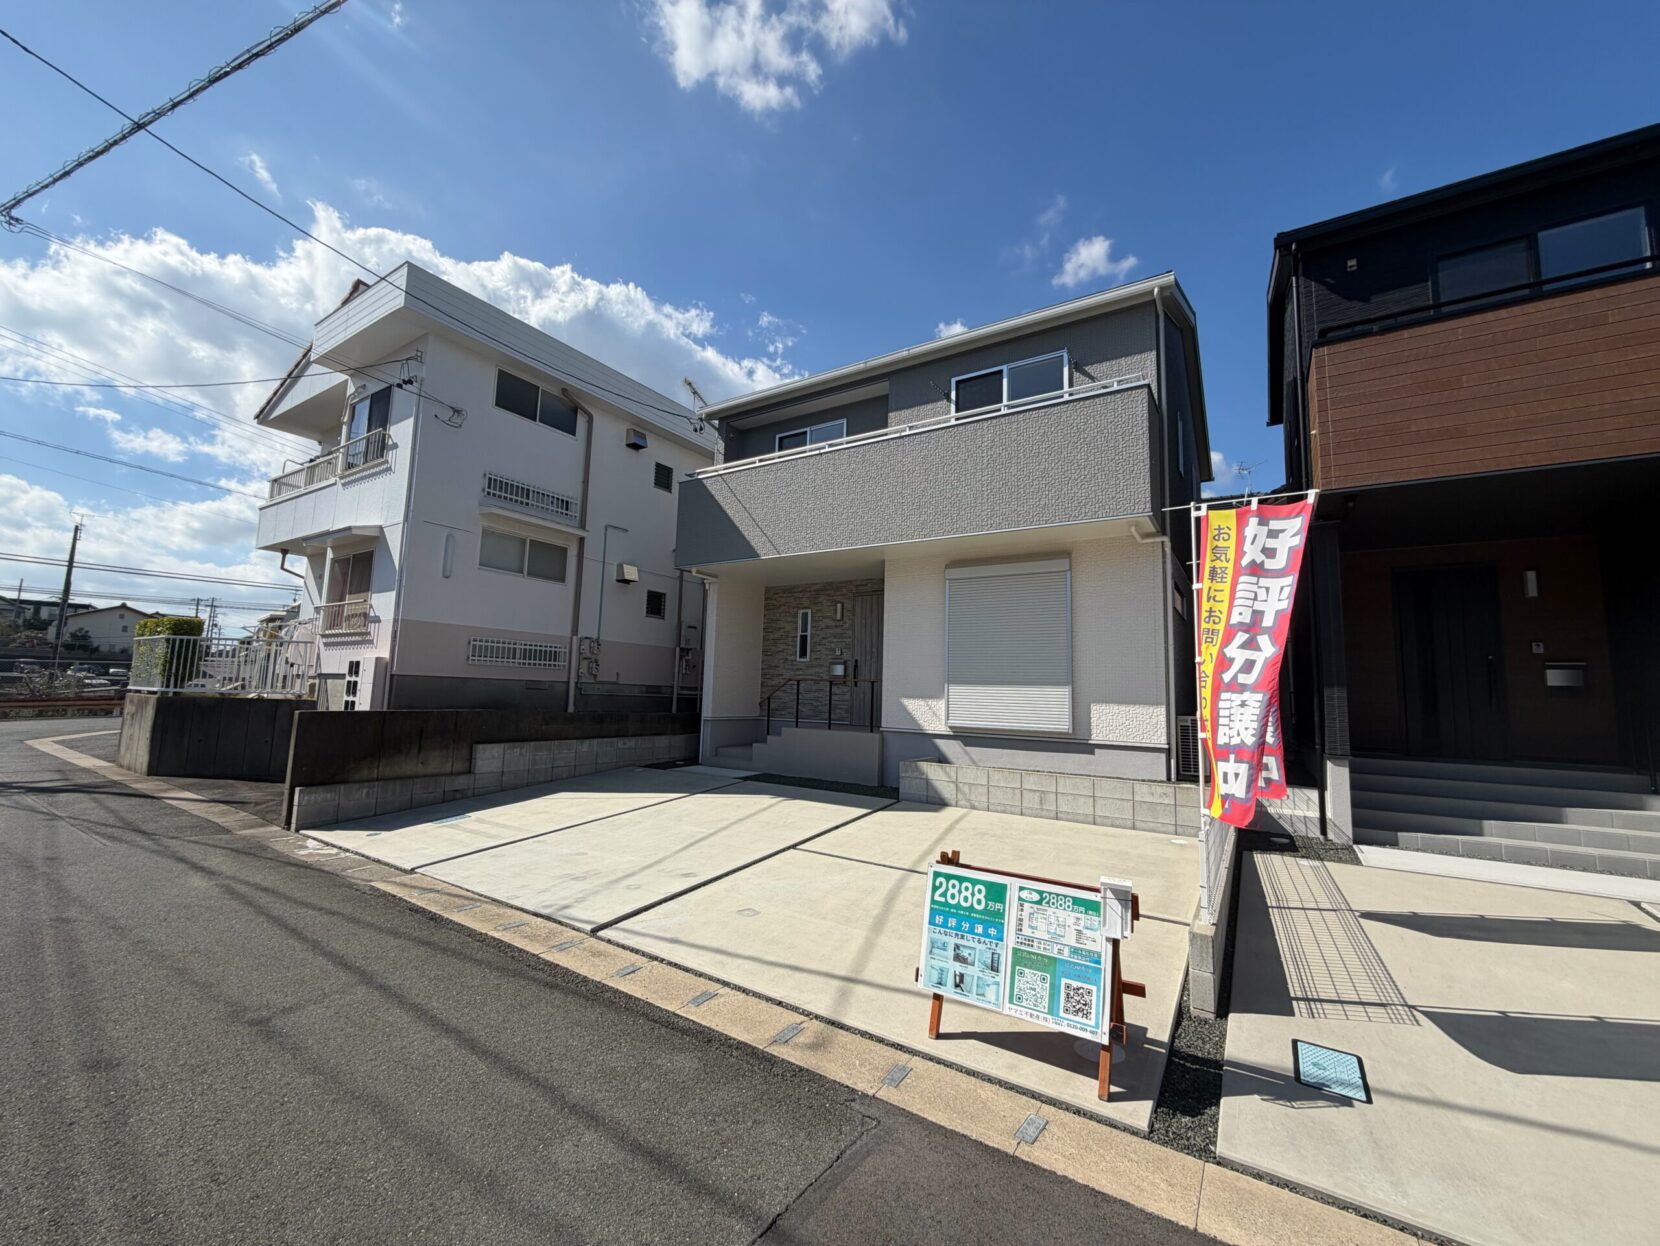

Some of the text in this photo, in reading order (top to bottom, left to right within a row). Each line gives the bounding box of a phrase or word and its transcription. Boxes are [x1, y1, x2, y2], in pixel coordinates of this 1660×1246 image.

[1216, 516, 1303, 809] 好評分譲中
